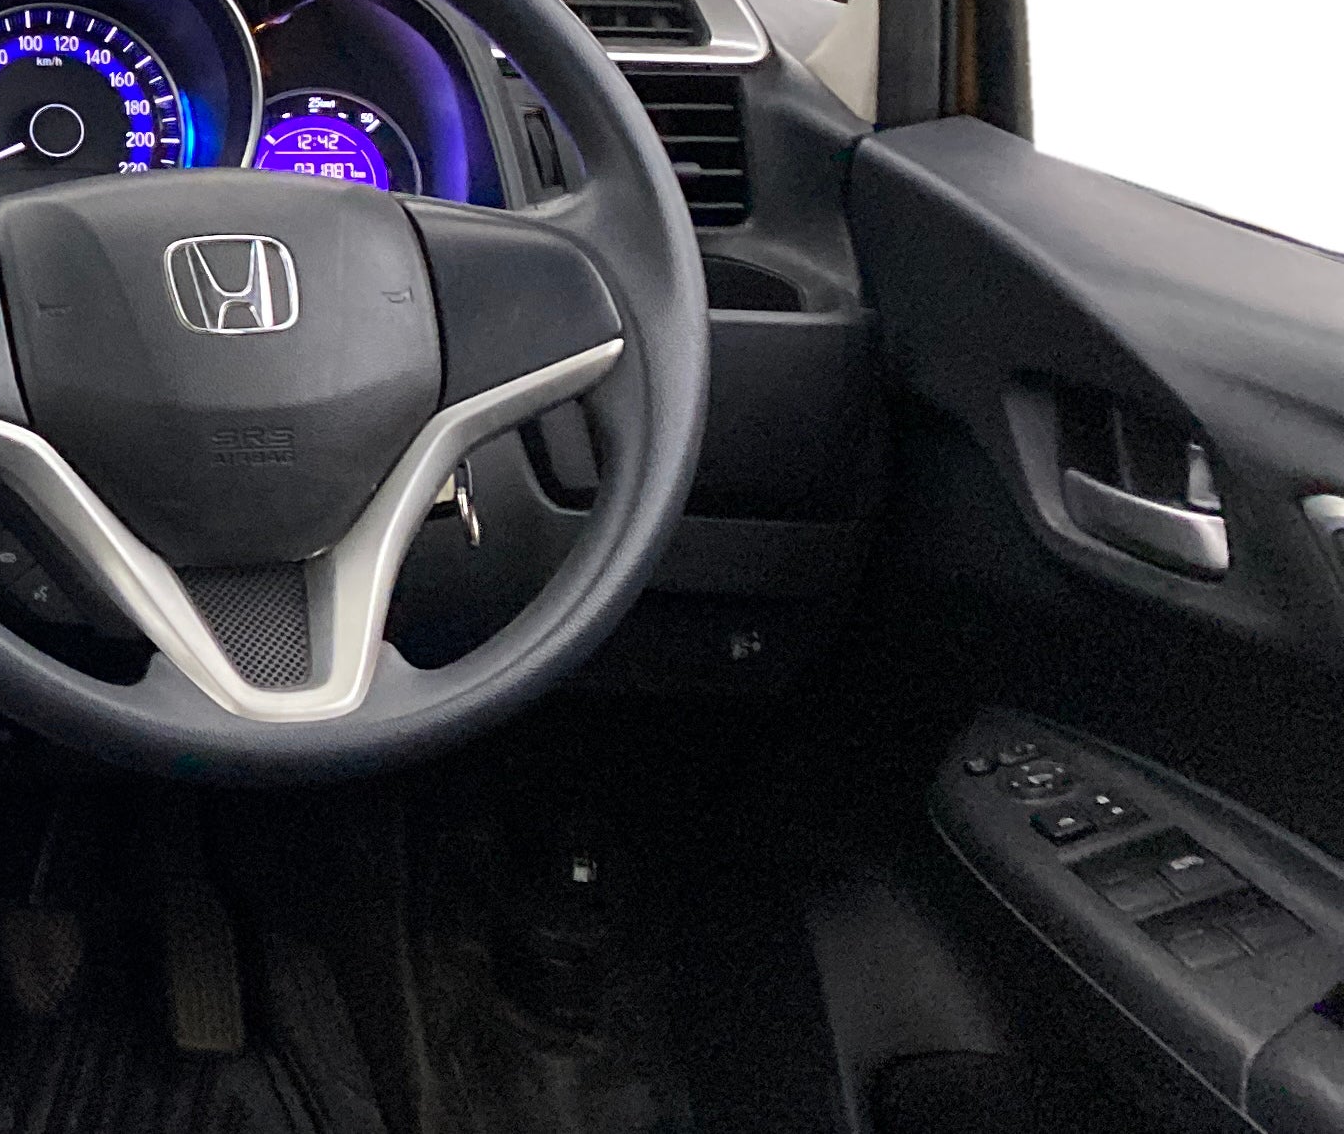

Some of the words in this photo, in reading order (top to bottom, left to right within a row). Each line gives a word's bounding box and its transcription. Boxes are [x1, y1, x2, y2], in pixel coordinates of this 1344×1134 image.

[18, 36, 42, 51] 100
[54, 36, 79, 51] 120
[36, 57, 62, 66] km/h
[85, 50, 111, 65] 140
[110, 72, 135, 87] 160
[125, 100, 150, 115] 180
[126, 132, 155, 147] 200
[297, 134, 339, 150] 12:42
[211, 426, 295, 448] SRS
